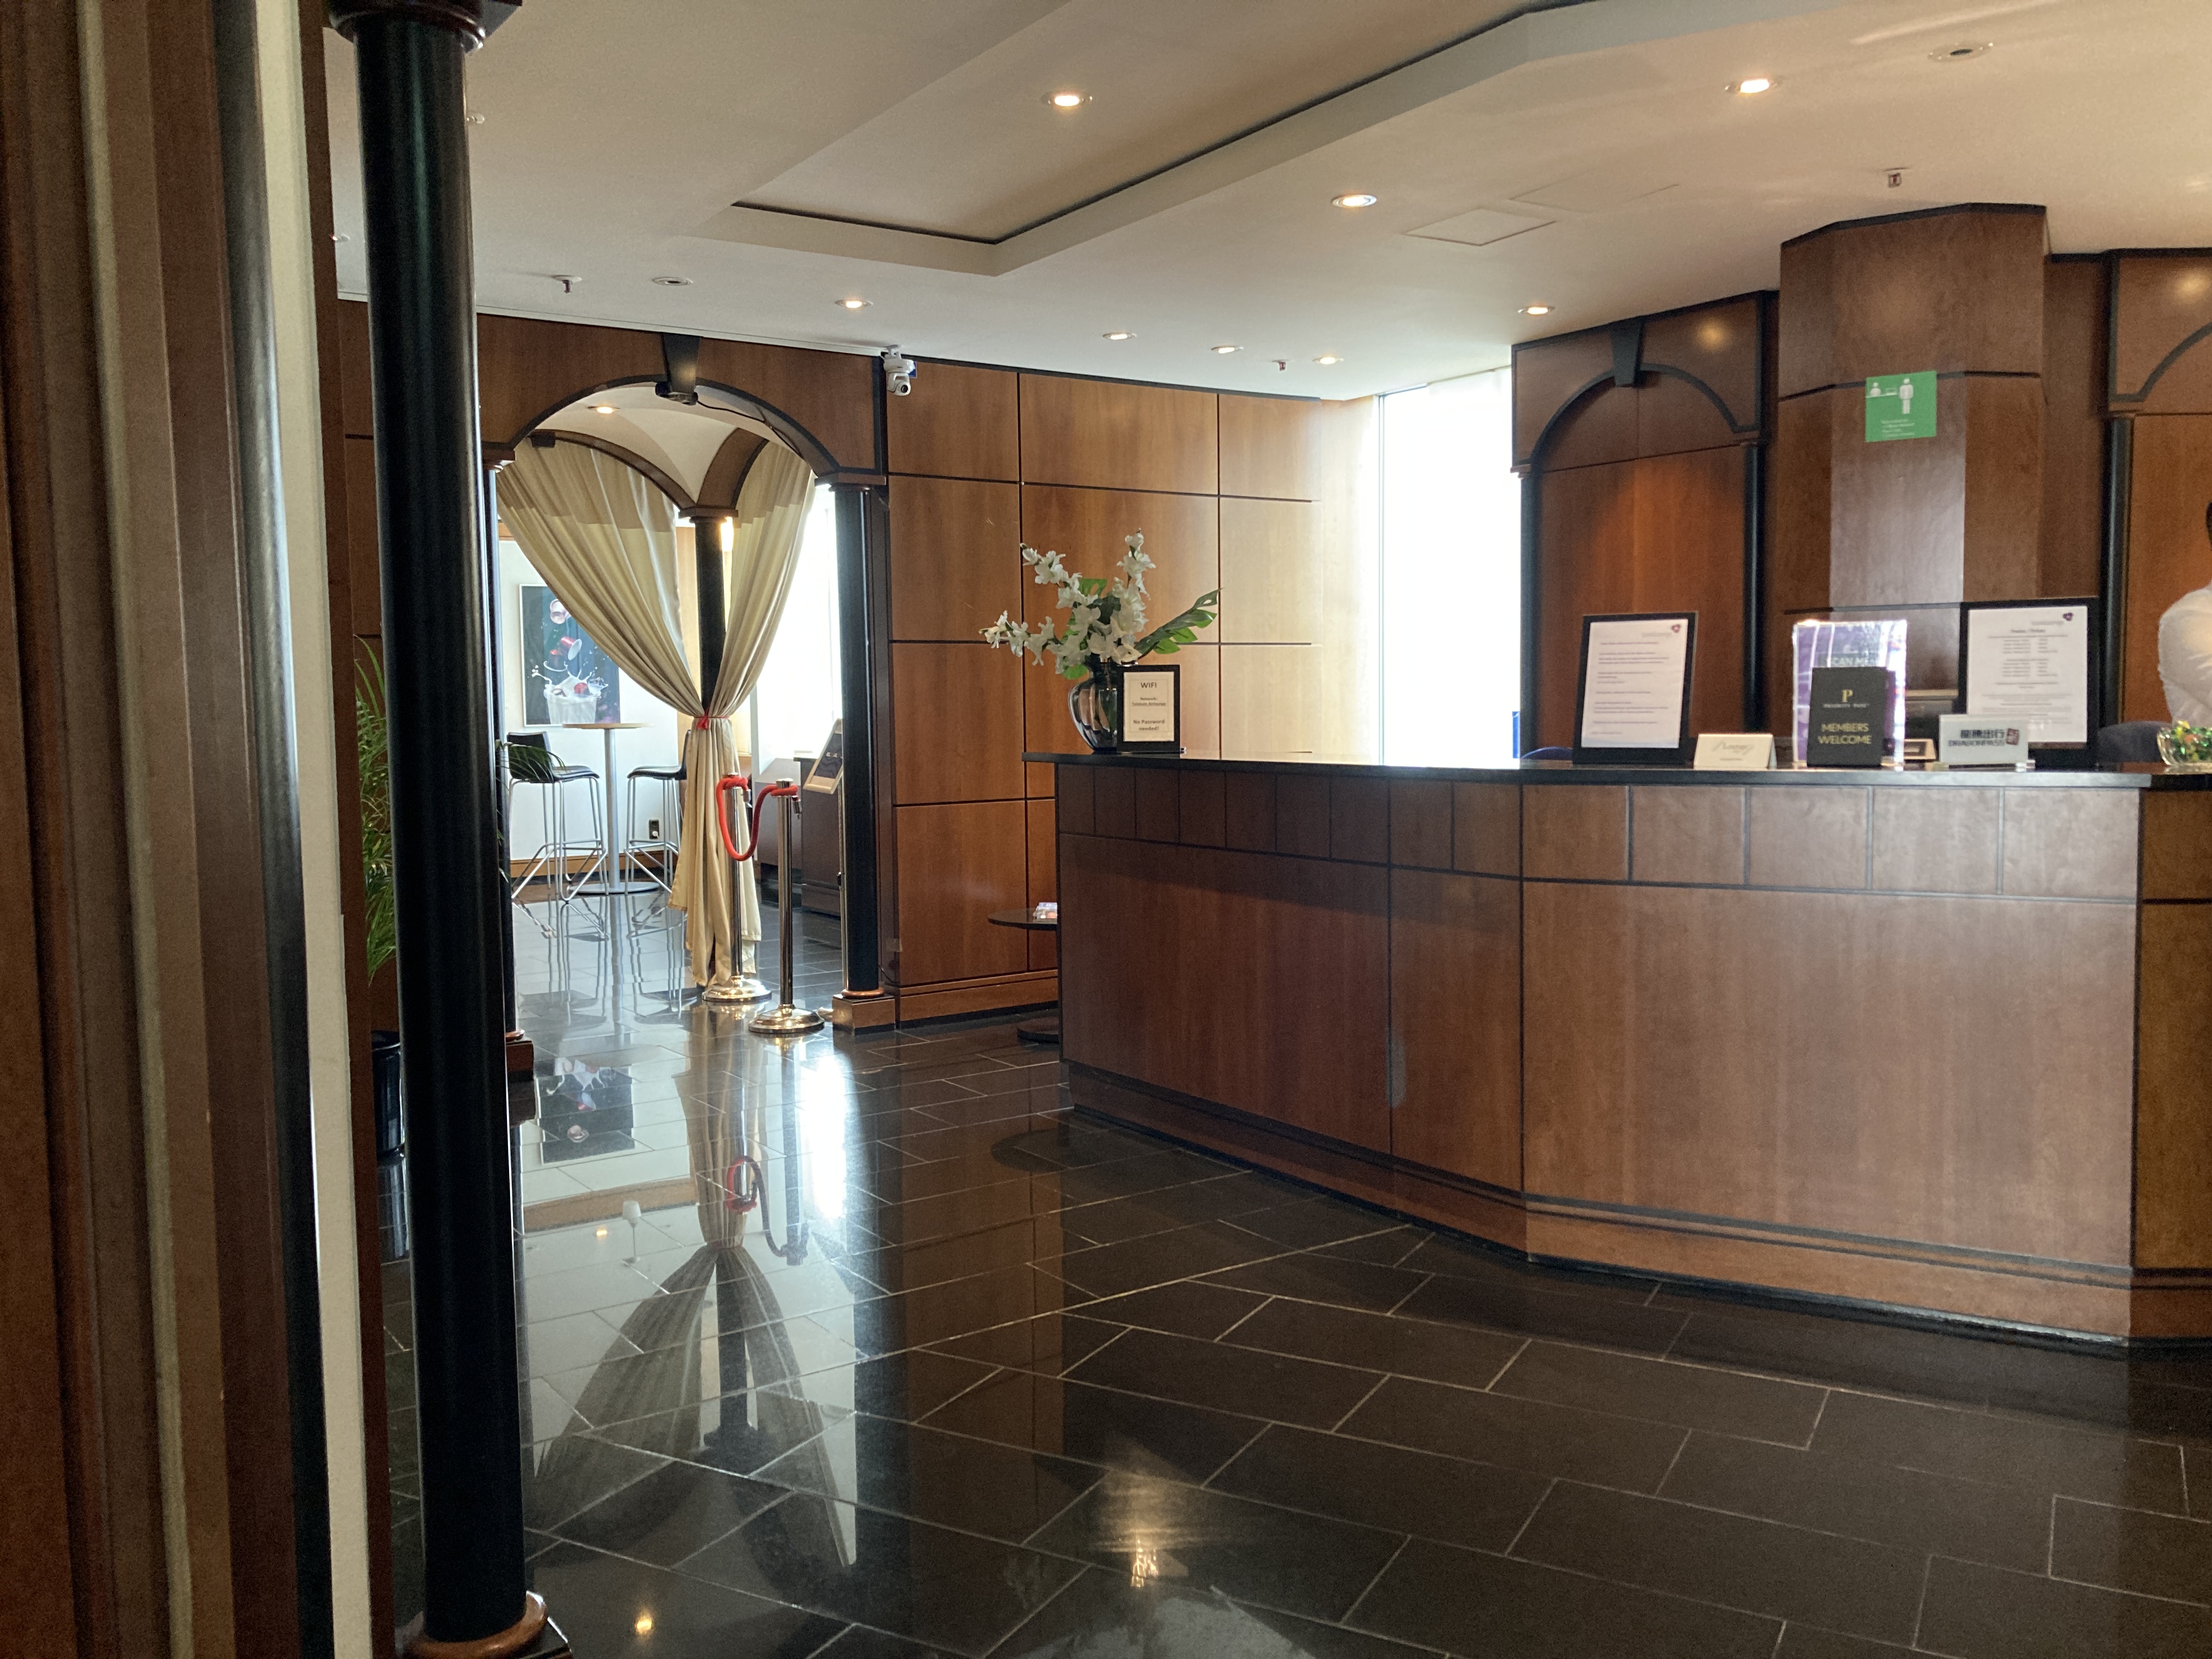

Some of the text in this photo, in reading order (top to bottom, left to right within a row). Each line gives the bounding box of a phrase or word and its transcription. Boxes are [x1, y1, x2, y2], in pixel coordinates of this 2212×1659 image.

[1842, 689, 1854, 703] P
[1821, 723, 1869, 732] MEMBERS
[1818, 735, 1872, 745] WELCOME
